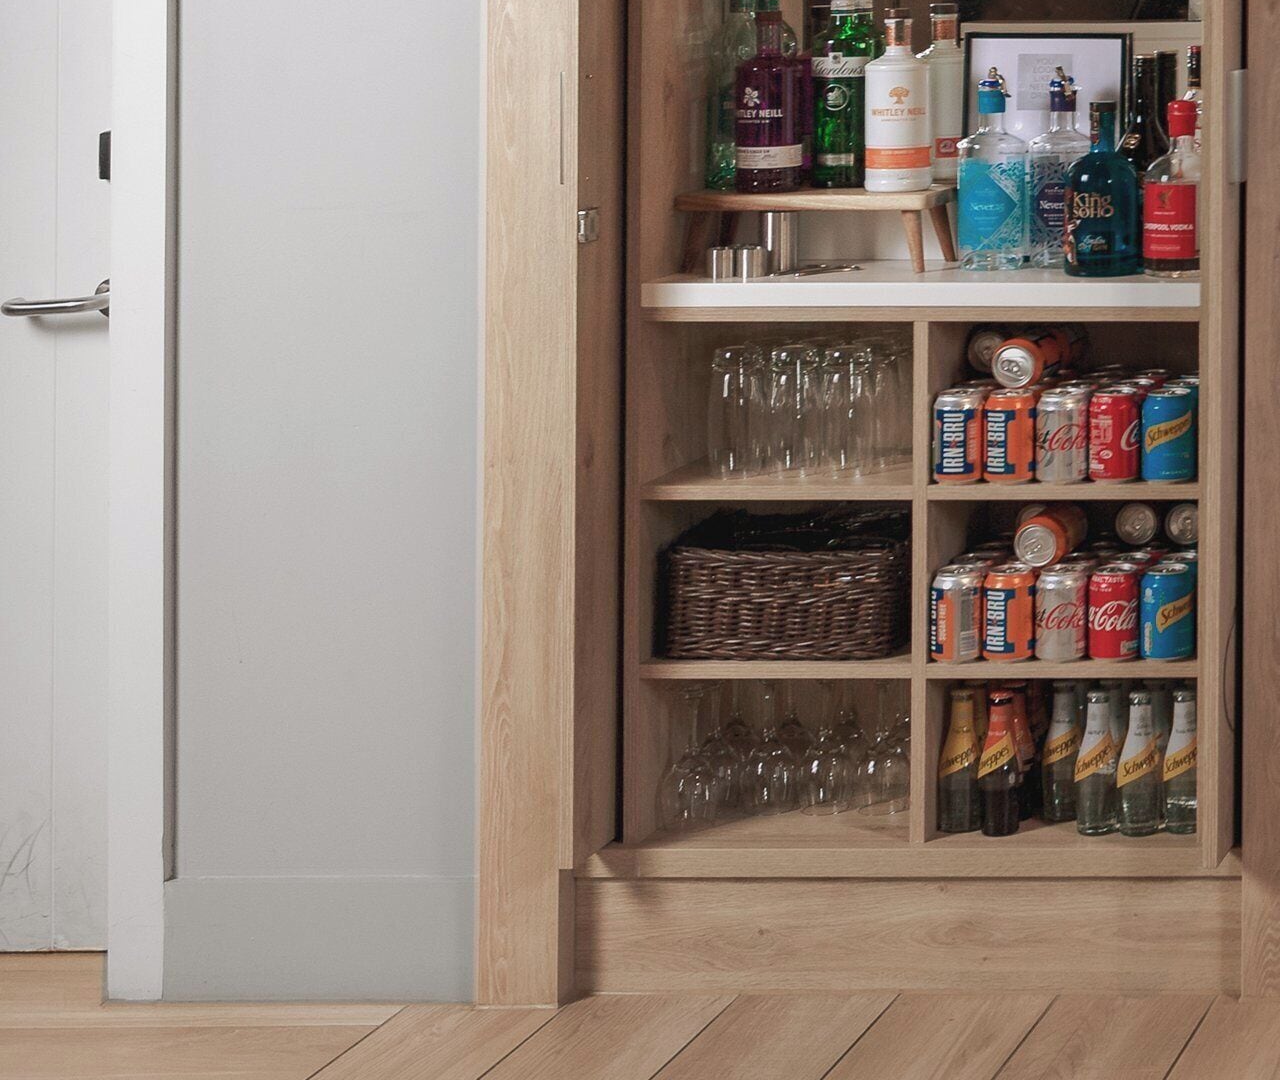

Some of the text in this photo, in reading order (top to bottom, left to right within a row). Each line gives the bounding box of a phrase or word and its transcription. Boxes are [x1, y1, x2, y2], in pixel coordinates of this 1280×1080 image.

[813, 60, 864, 77] Gordon's
[872, 108, 904, 117] WHITLEY
[1073, 192, 1112, 213] King
[1072, 206, 1114, 219] SOHO
